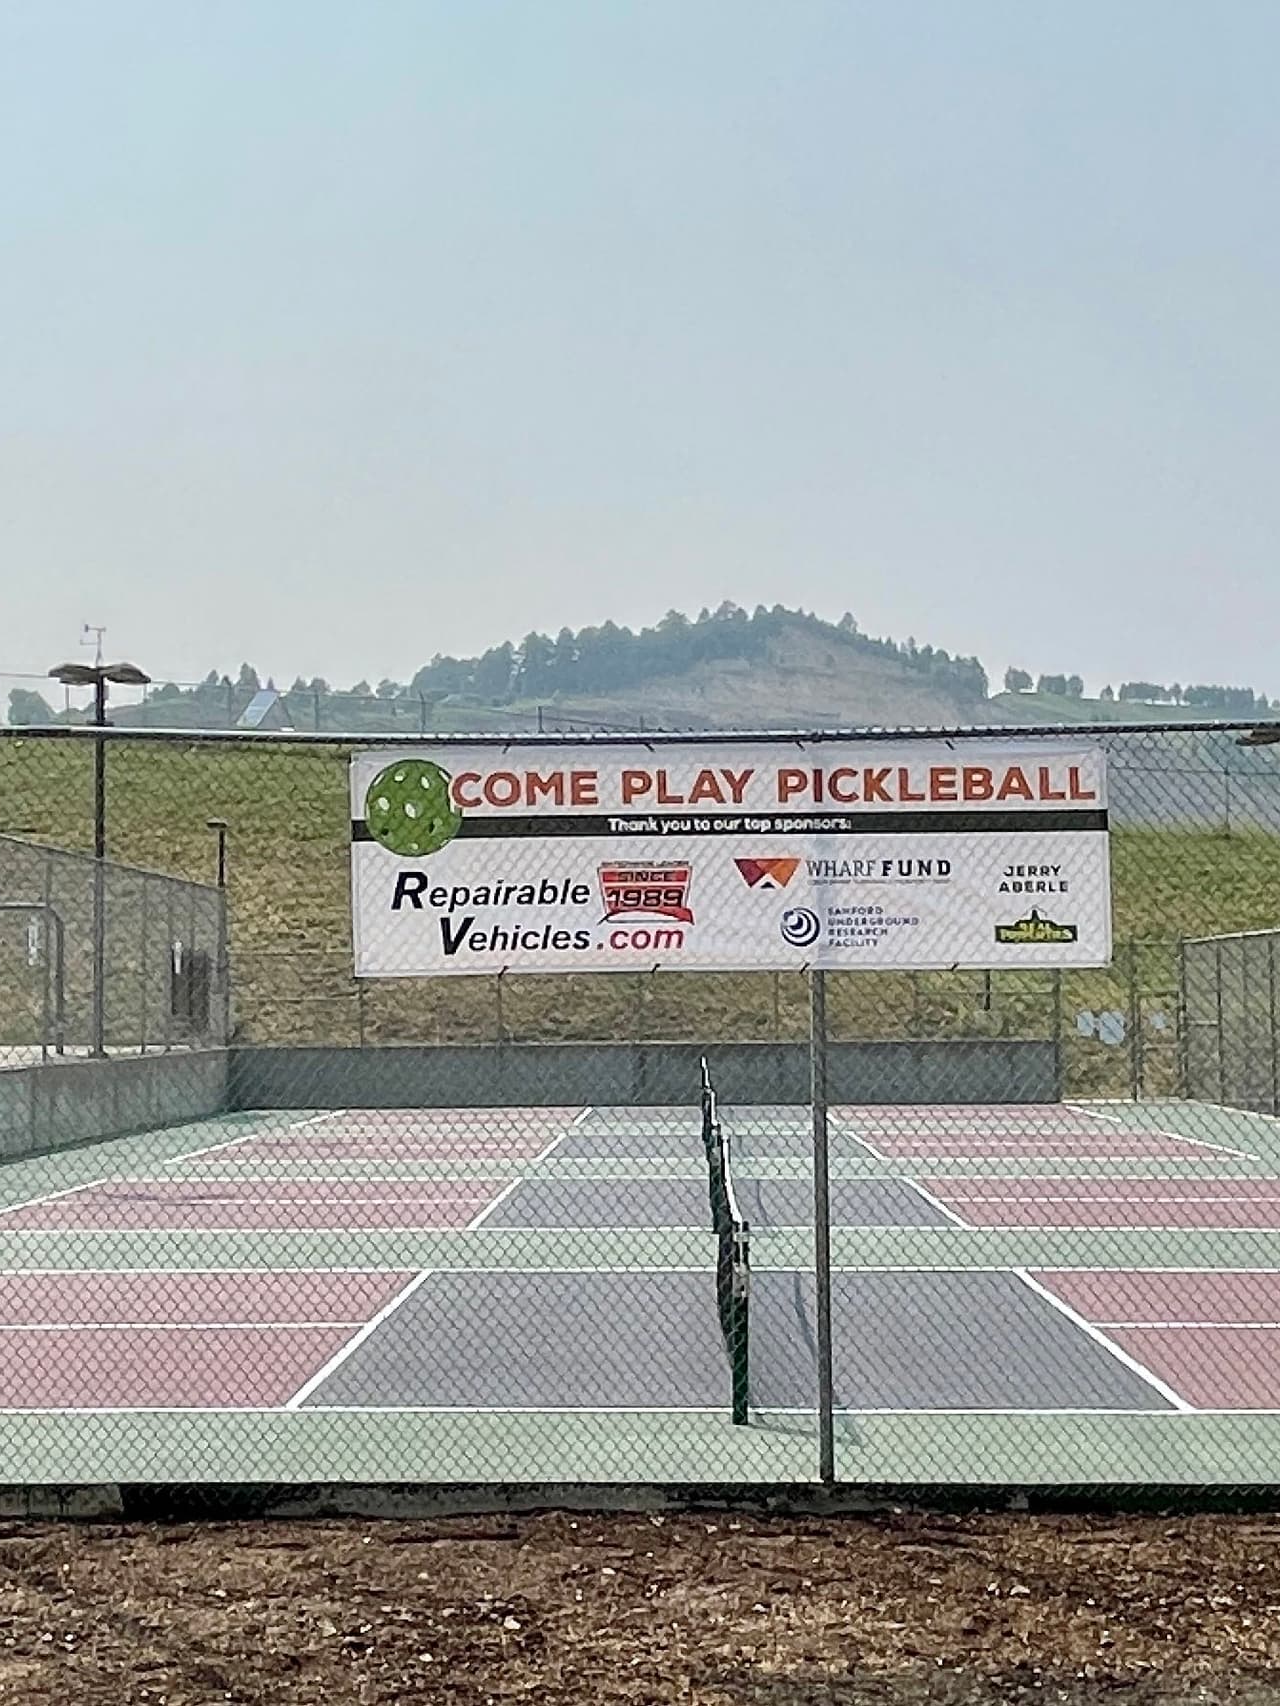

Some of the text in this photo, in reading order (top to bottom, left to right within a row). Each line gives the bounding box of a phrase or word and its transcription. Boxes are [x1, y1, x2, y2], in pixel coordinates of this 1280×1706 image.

[451, 766, 1097, 808] COME PLAY PICKLEBALL
[608, 817, 853, 835] Thank you to our top sponsors:
[806, 859, 952, 877] WHARF FUND
[1003, 865, 1062, 877] JERRY
[617, 871, 675, 882] SINCE
[391, 871, 591, 913] Repairable
[999, 880, 1069, 893] ABERLE
[607, 888, 684, 908] 1989
[827, 906, 884, 916] SANFORD
[827, 916, 919, 926] UNDERGROUND
[827, 927, 888, 937] RESEARCH
[828, 938, 879, 948] FACILITY
